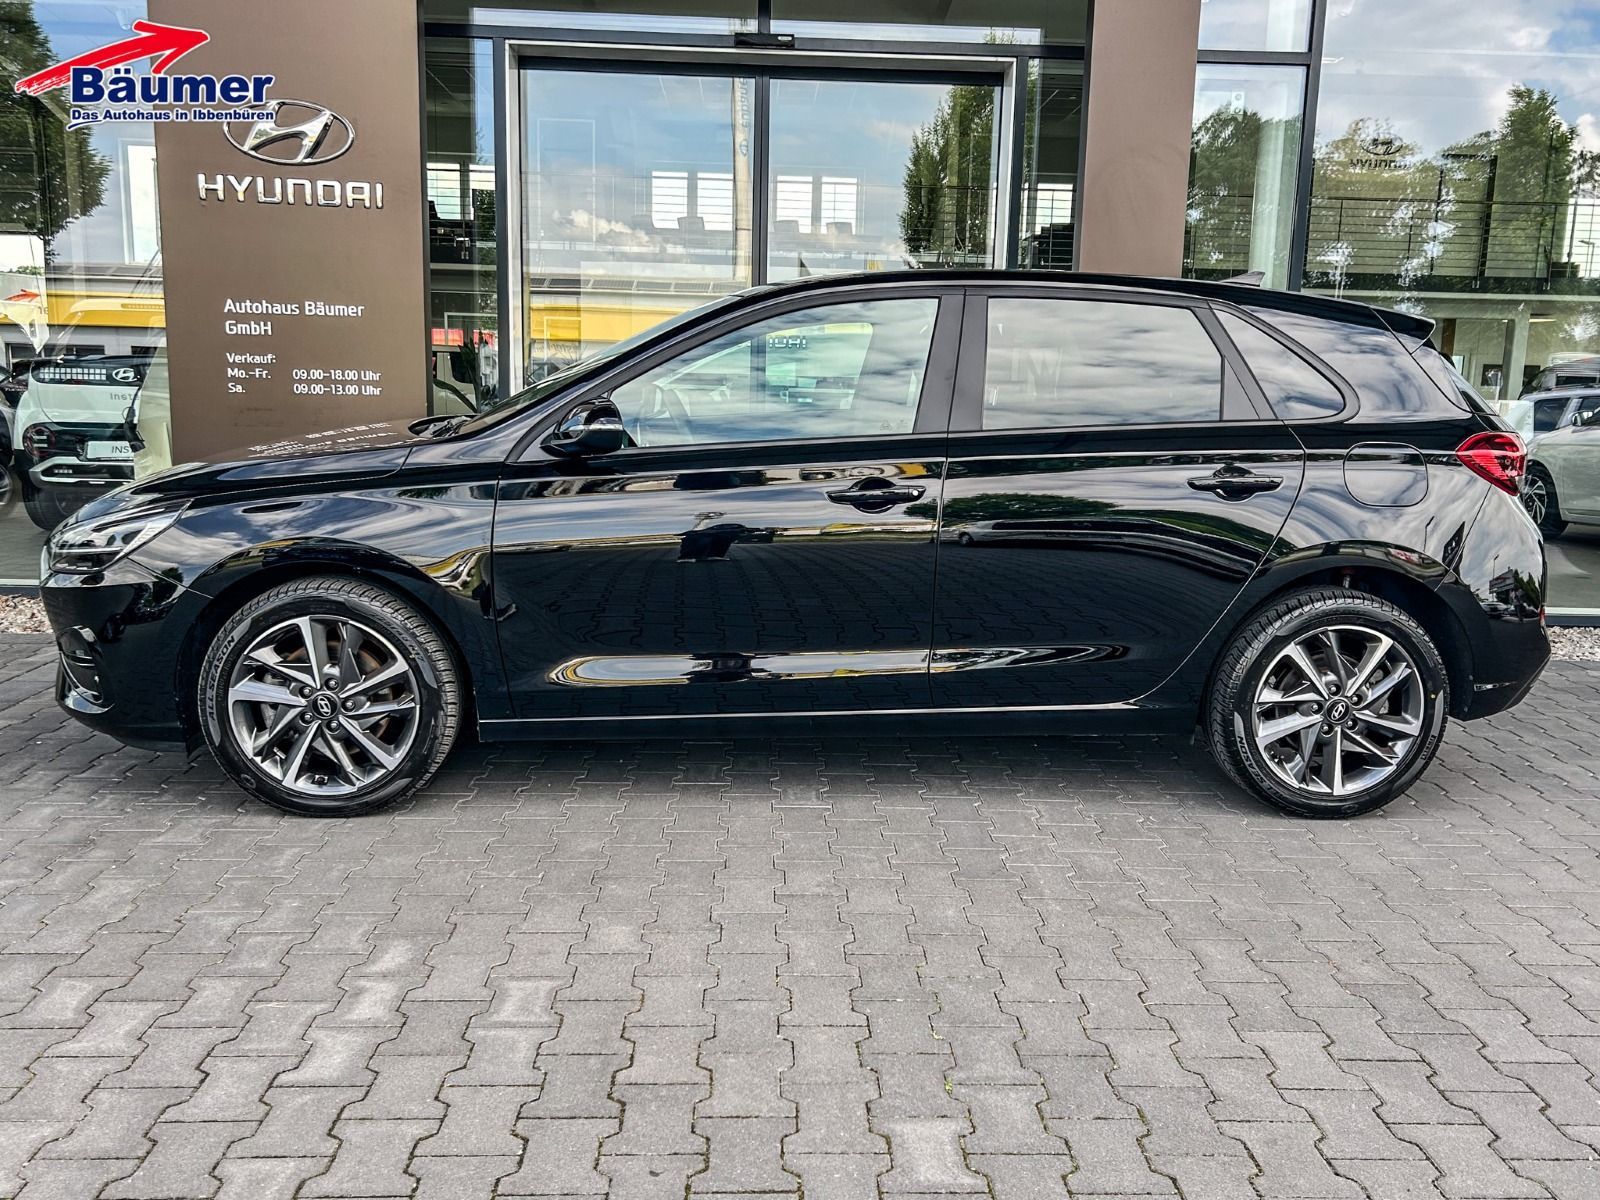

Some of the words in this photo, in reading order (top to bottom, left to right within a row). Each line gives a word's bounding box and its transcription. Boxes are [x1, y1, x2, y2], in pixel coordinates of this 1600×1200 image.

[197, 173, 384, 209] HYUNDAI
[223, 298, 300, 315] Autohaus
[304, 301, 365, 317] Bäumer
[225, 320, 273, 336] GmbH
[226, 352, 276, 364] Verkauf:
[227, 367, 272, 379] Mo.-Fr.
[292, 369, 359, 381] 09.00-18.00
[361, 370, 382, 381] Uhr
[110, 392, 138, 401] Inst
[228, 382, 246, 393] Sa.
[293, 384, 359, 395] 09.00-13.00
[361, 384, 383, 396] Uhr
[111, 445, 133, 454] INS
[208, 635, 236, 692] SEASON
[207, 694, 216, 721] ALL
